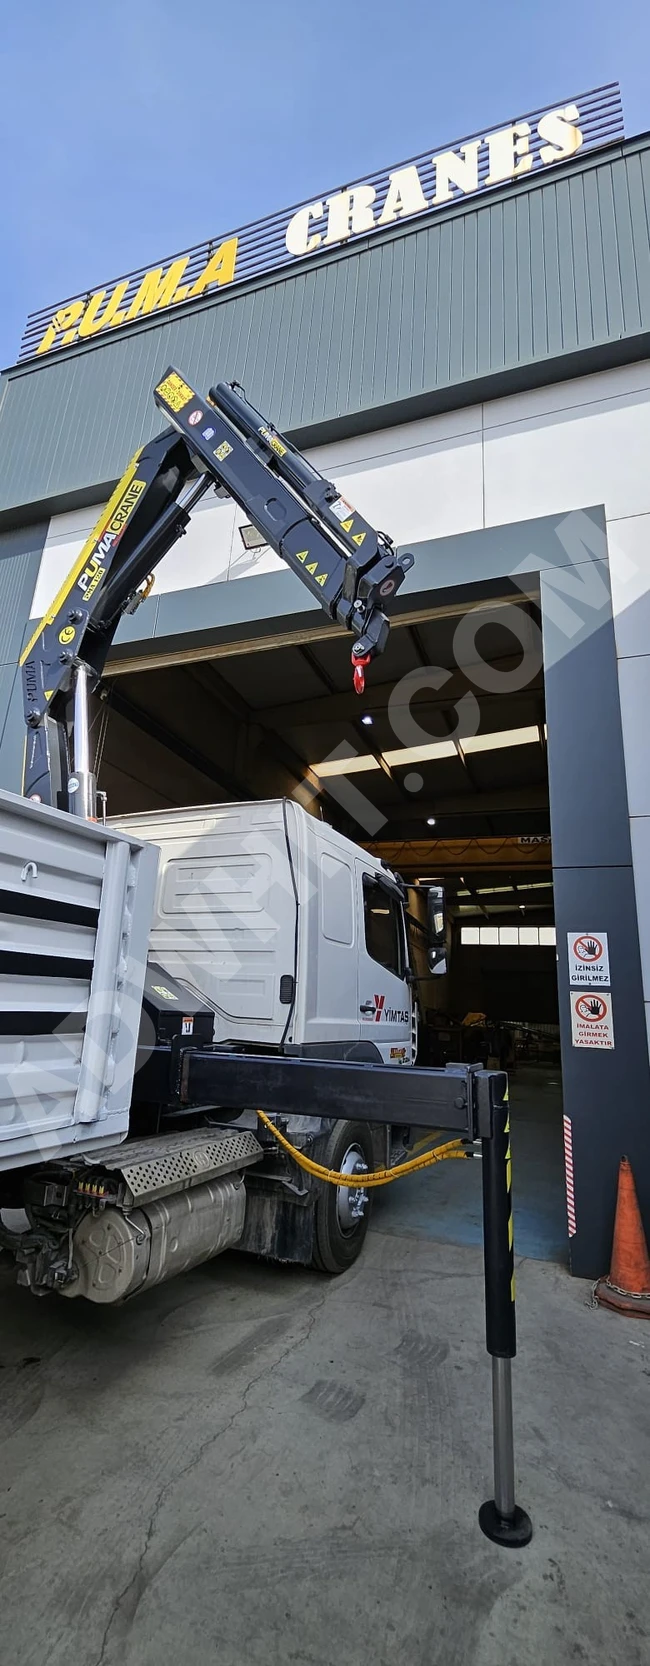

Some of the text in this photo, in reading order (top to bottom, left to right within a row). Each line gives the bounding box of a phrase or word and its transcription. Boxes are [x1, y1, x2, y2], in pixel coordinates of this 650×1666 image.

[35, 104, 584, 354] P.U.M.A CRANES
[77, 483, 143, 592] PUMA CRANE
[25, 660, 38, 702] PUMA
[520, 836, 551, 844] MAS
[575, 964, 604, 972] İZİNSİZ
[571, 974, 609, 982] GİRİLMEZ
[384, 1007, 409, 1025] YİMTAŞ
[576, 1022, 609, 1031] İMALATA
[578, 1031, 608, 1039] GİRMEK
[574, 1039, 613, 1047] YASAKTIR
